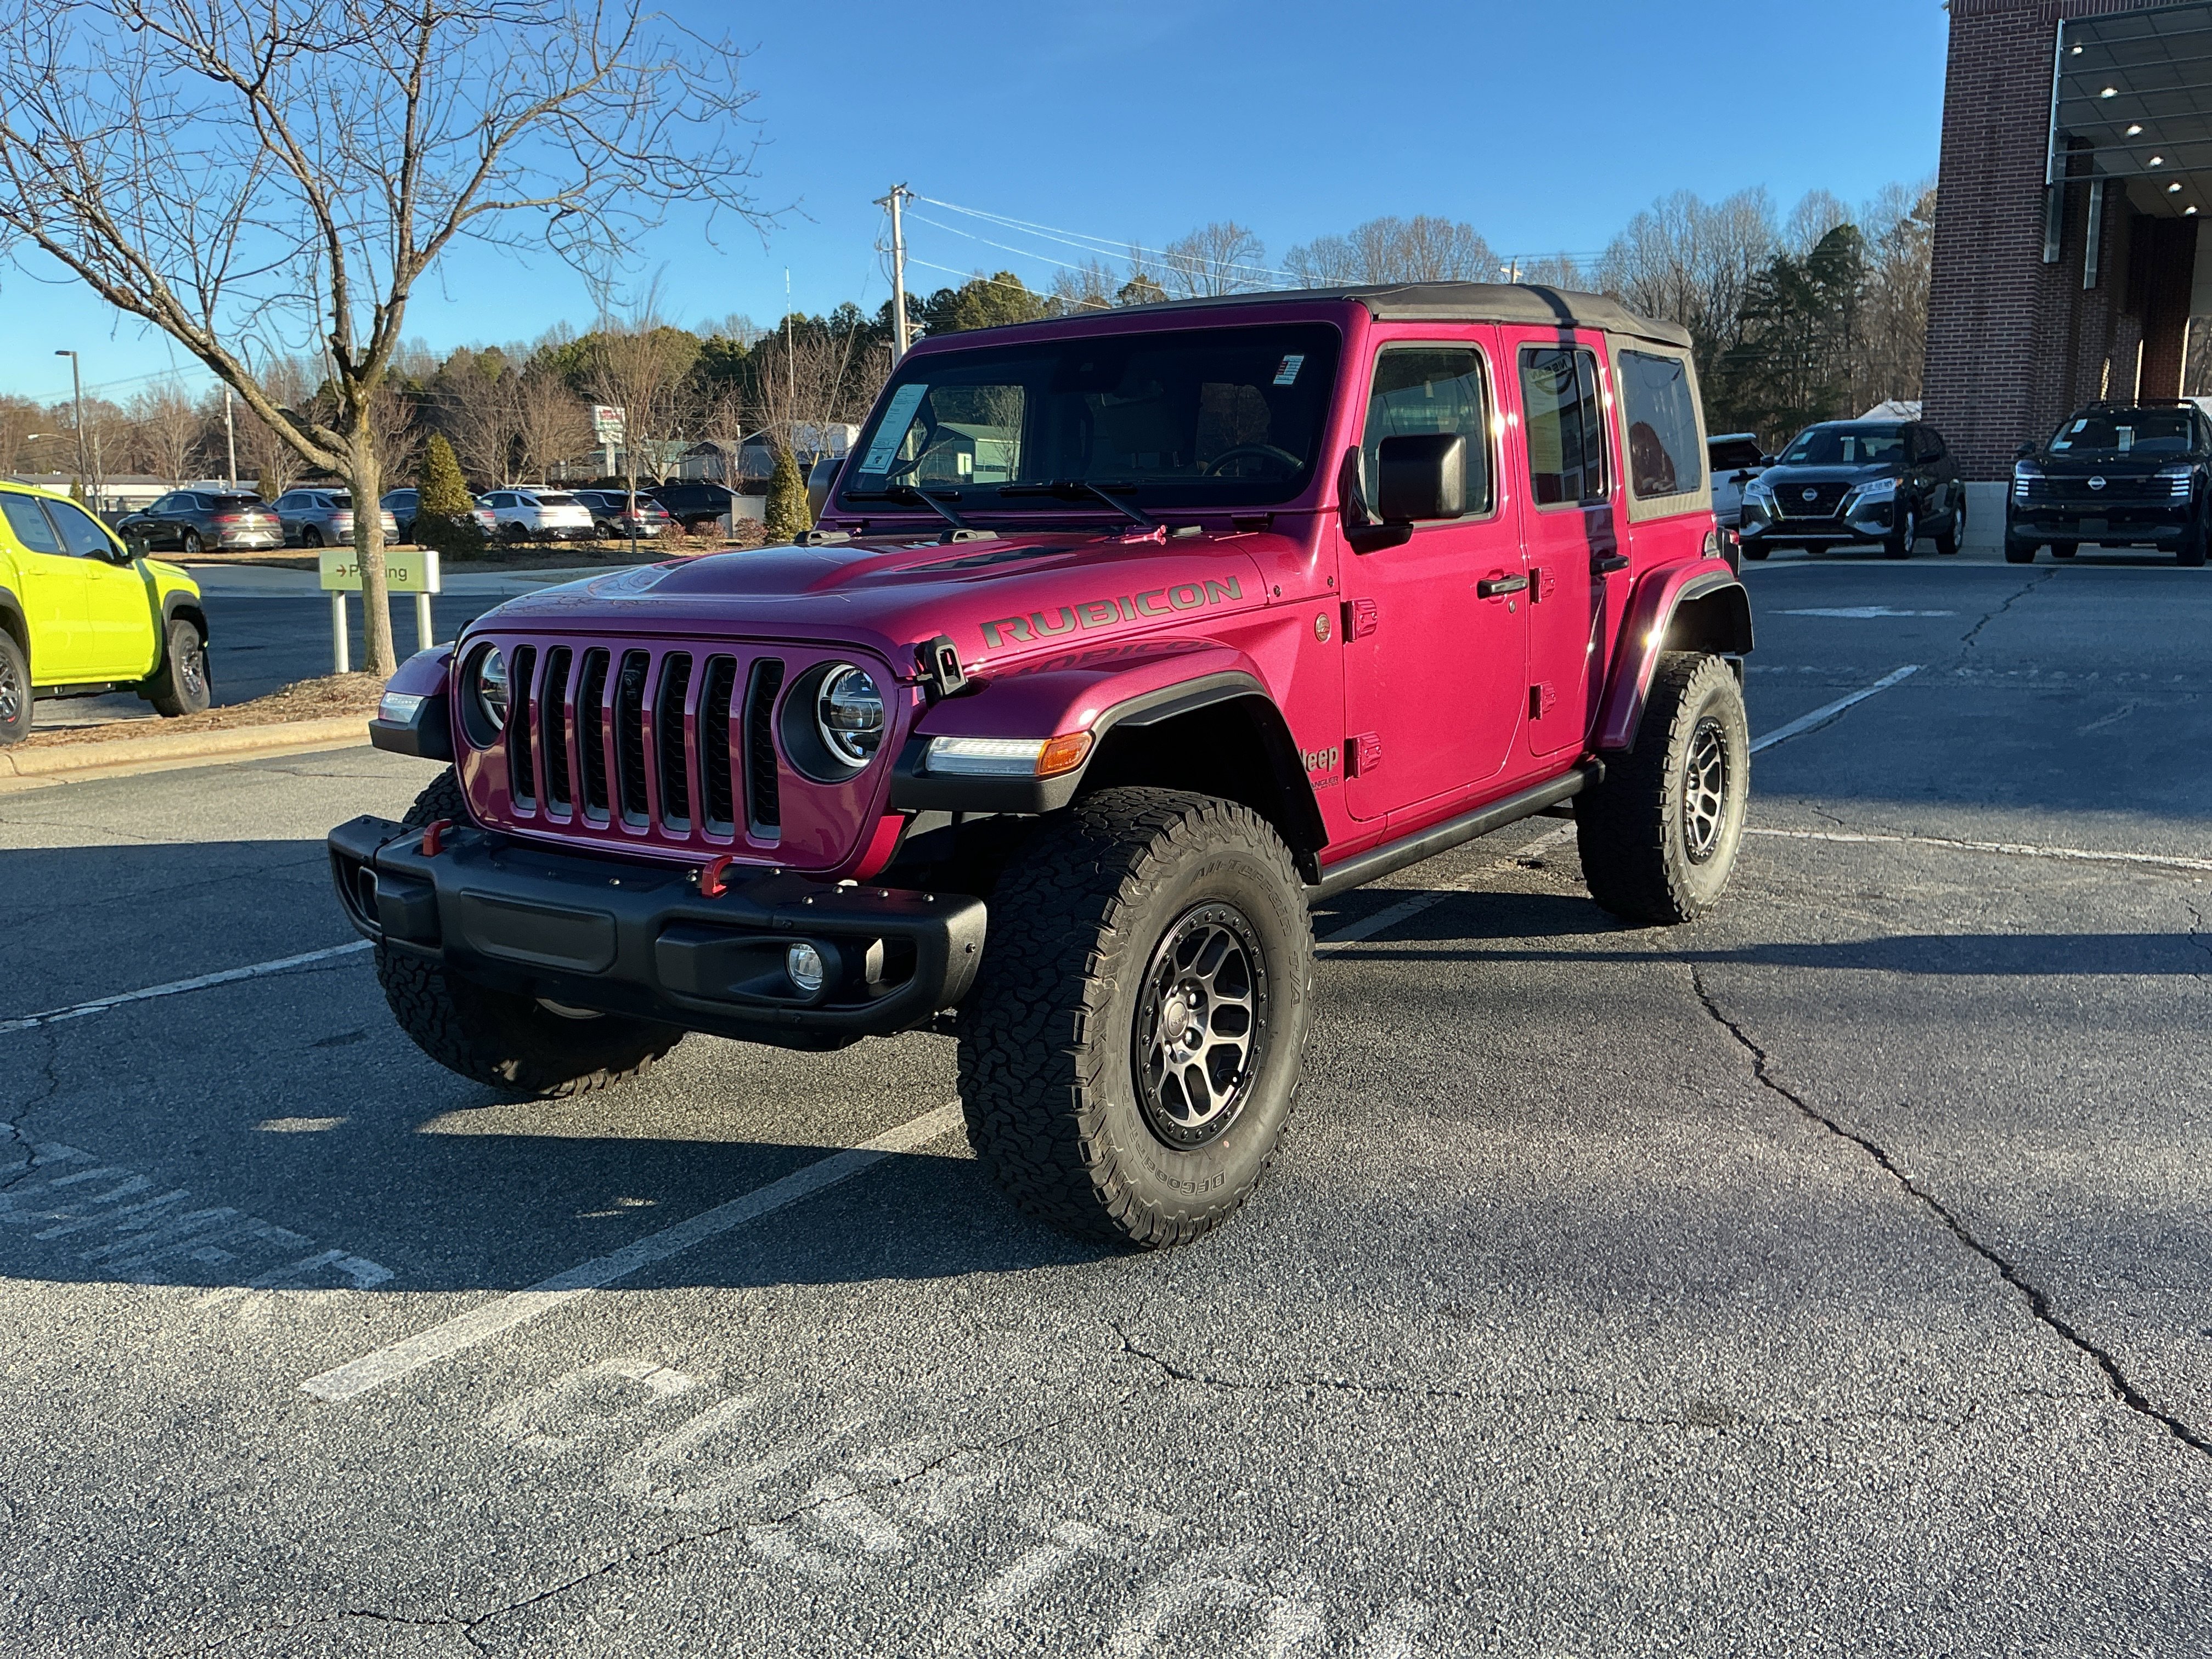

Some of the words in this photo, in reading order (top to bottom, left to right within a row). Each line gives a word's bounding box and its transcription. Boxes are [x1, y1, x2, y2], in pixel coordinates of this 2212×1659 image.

[349, 564, 408, 582] Ping
[980, 575, 1243, 649] RUBICON
[1288, 950, 1301, 1009] T/A
[1121, 1081, 1227, 1196] BFGoodrich
